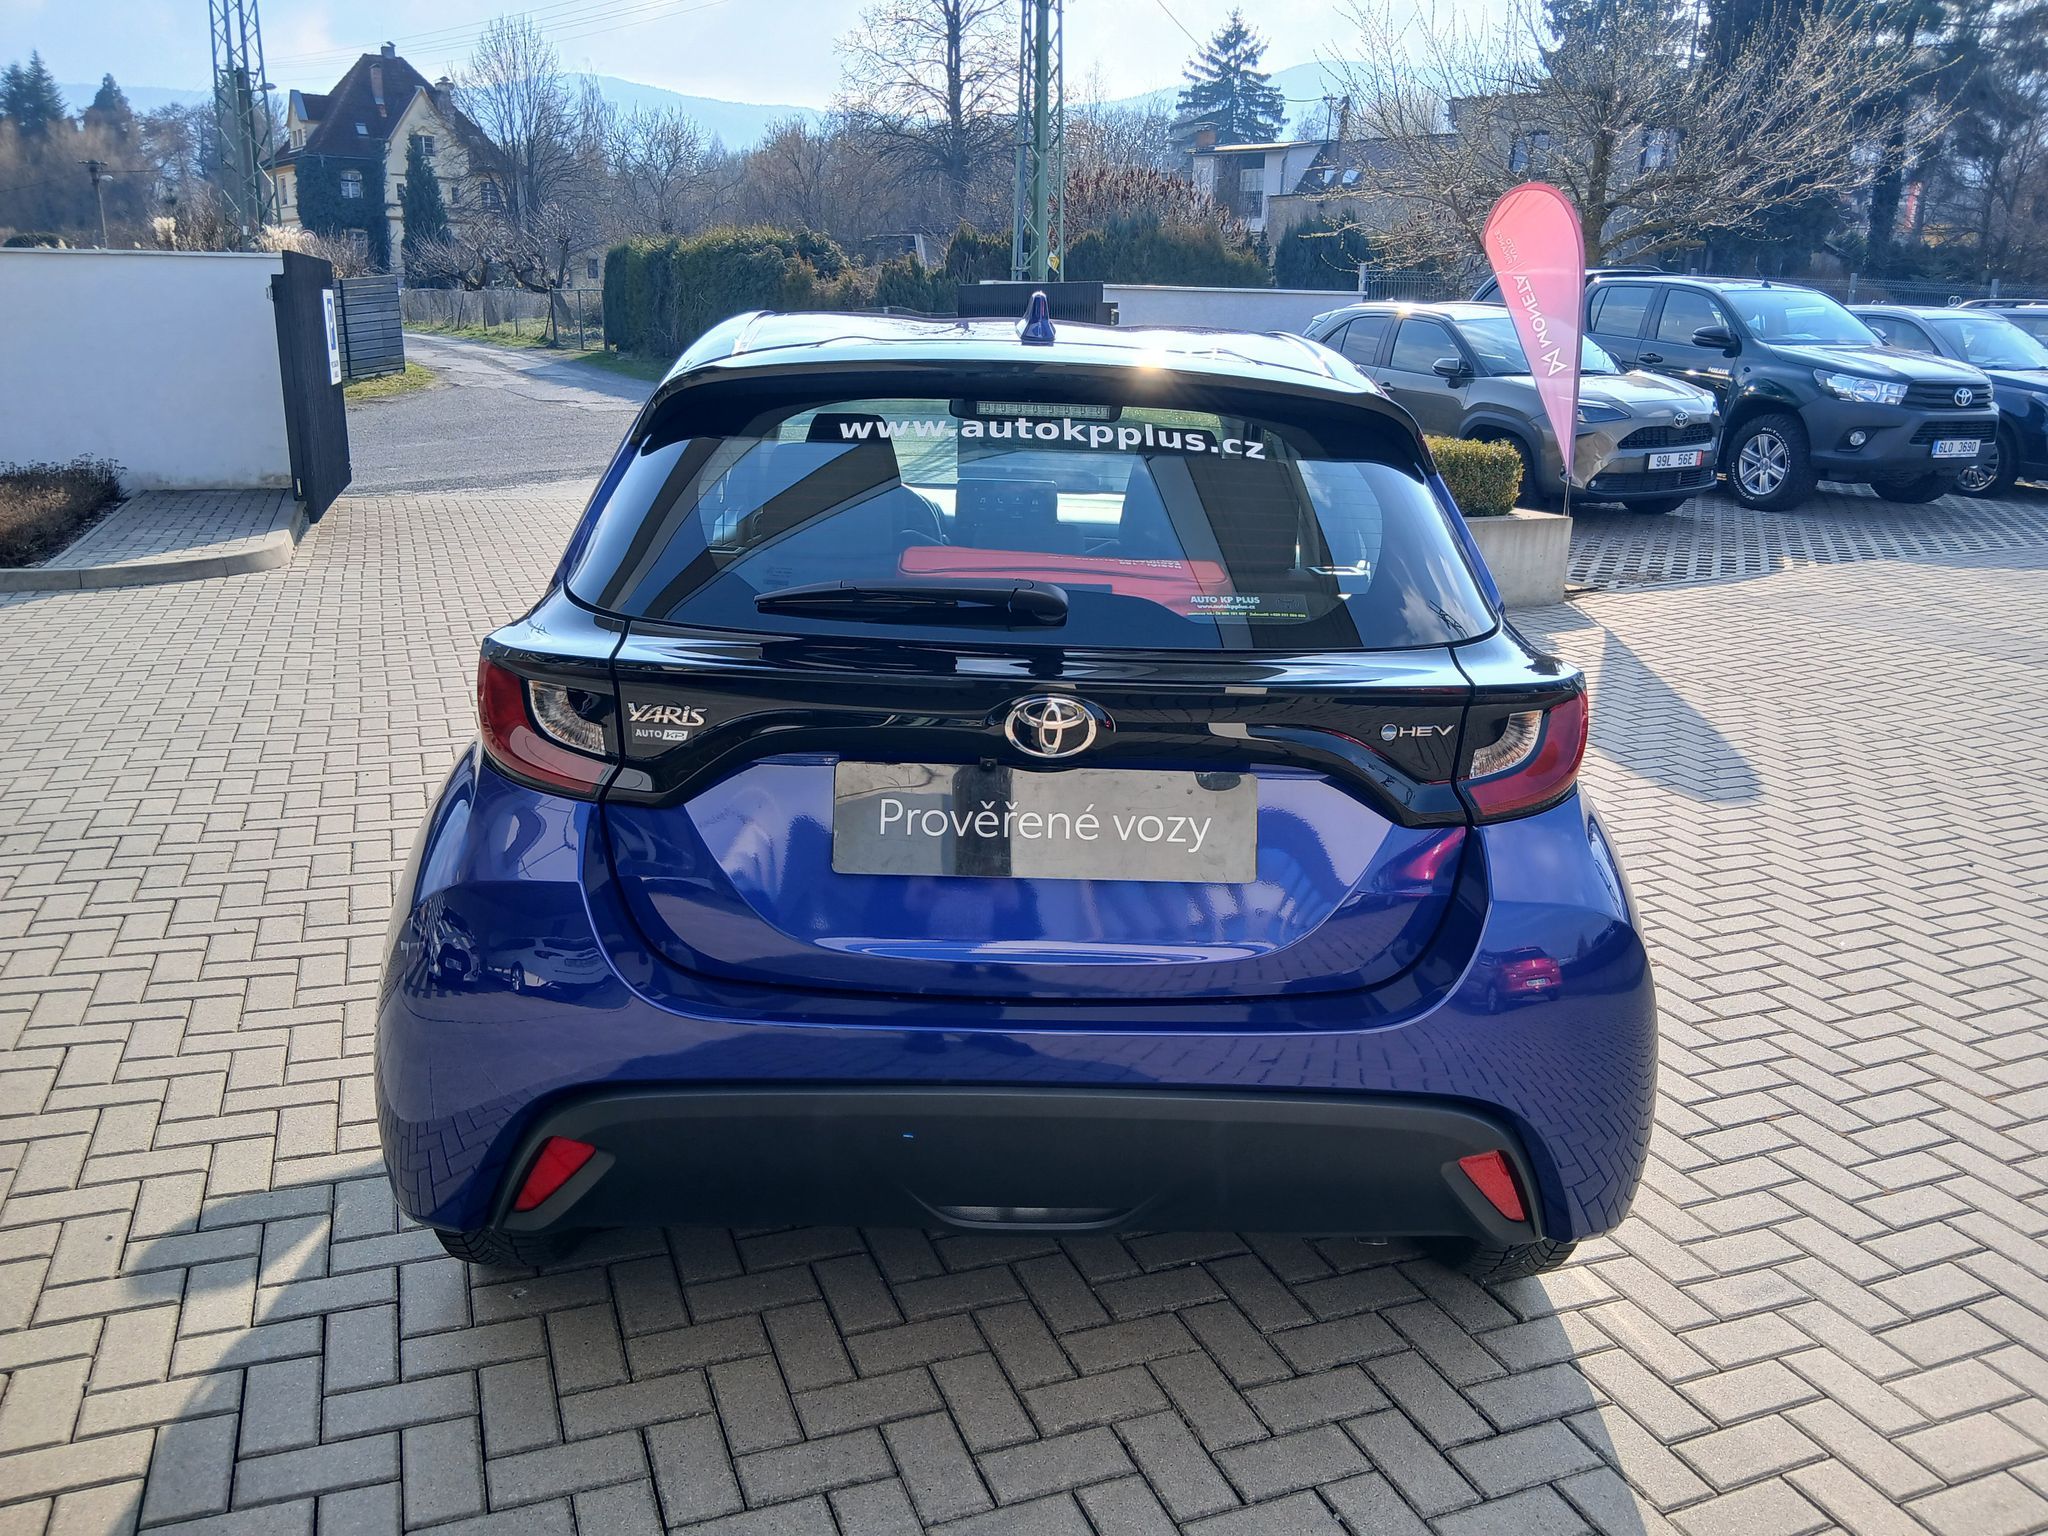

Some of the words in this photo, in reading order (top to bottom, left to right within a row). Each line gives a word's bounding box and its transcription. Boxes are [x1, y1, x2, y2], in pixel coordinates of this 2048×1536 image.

[839, 417, 1267, 460] www.autokpplus.cz
[1656, 455, 1671, 467] 99L
[1190, 595, 1218, 604] AUTO
[1220, 596, 1234, 604] KP
[1236, 596, 1260, 605] PLUS
[635, 728, 662, 738] AUTO
[1398, 724, 1455, 738] HEV
[878, 798, 1101, 841] Prověřené
[1113, 813, 1212, 853] vozy
